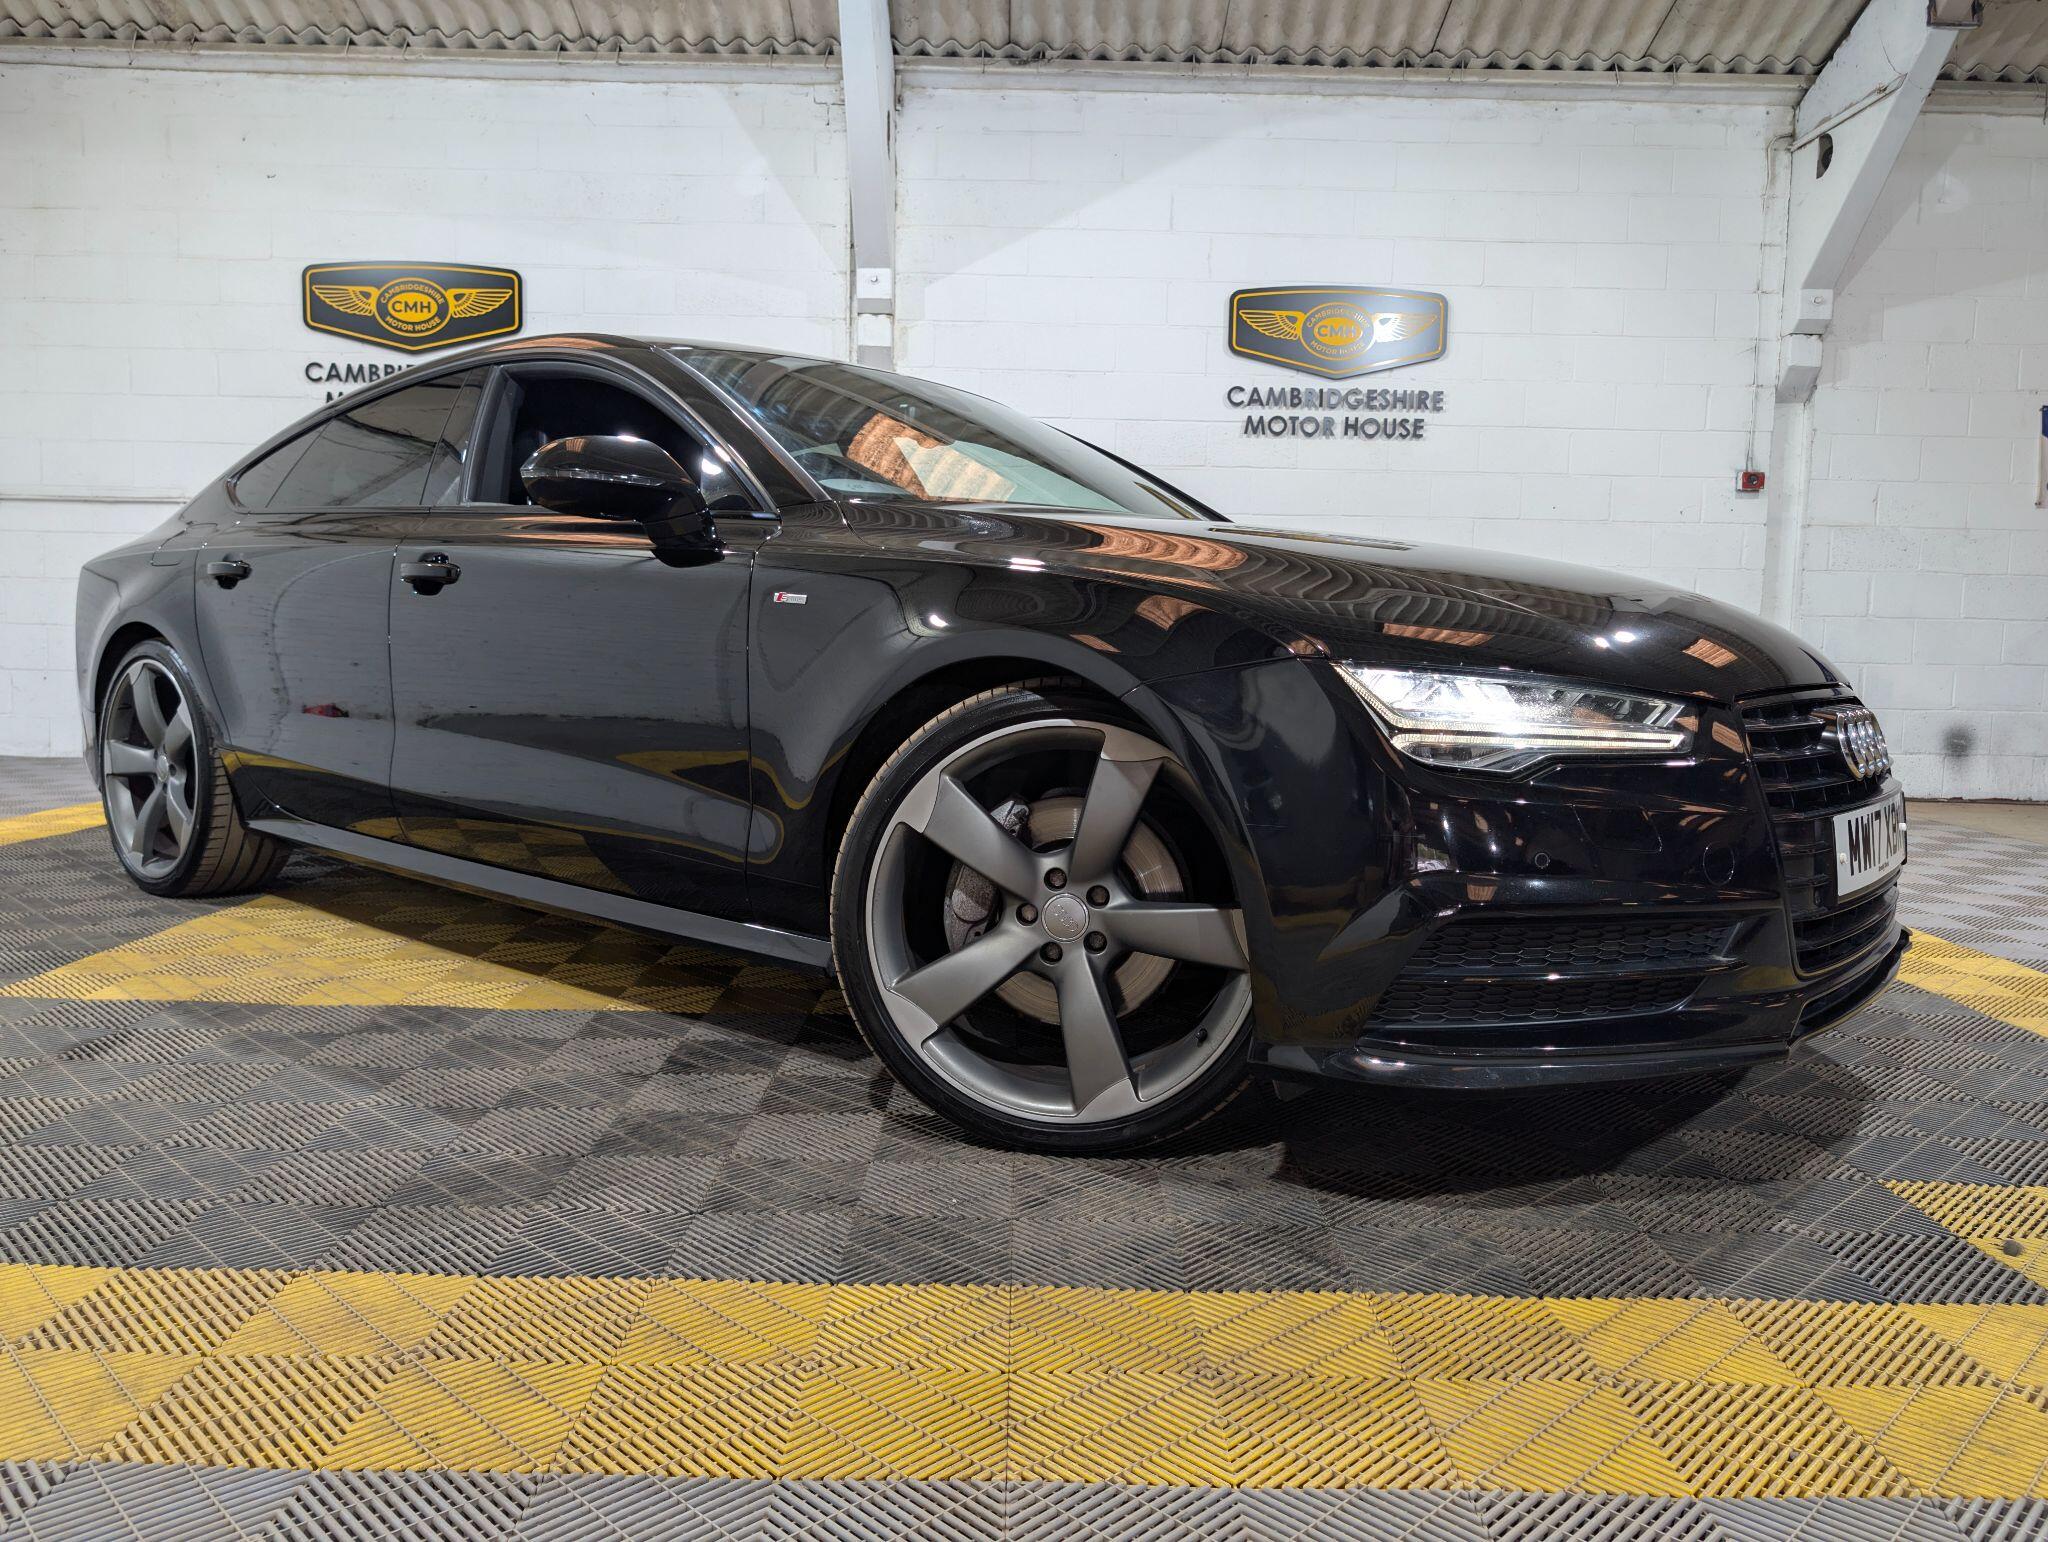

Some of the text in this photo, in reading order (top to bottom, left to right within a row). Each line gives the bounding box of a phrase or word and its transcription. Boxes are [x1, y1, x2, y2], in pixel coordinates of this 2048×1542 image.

[381, 283, 445, 304] CAMBRIDGESHIRE
[391, 300, 432, 314] CMH
[385, 315, 441, 331] MOTOR HOUSE
[1317, 325, 1357, 338] CMH
[1310, 340, 1338, 355] MOTOR
[1226, 385, 1445, 412] CAMBRIDGESHIRE
[1243, 415, 1425, 439] MOTOR HOUSE
[1847, 809, 1881, 876] MW17
